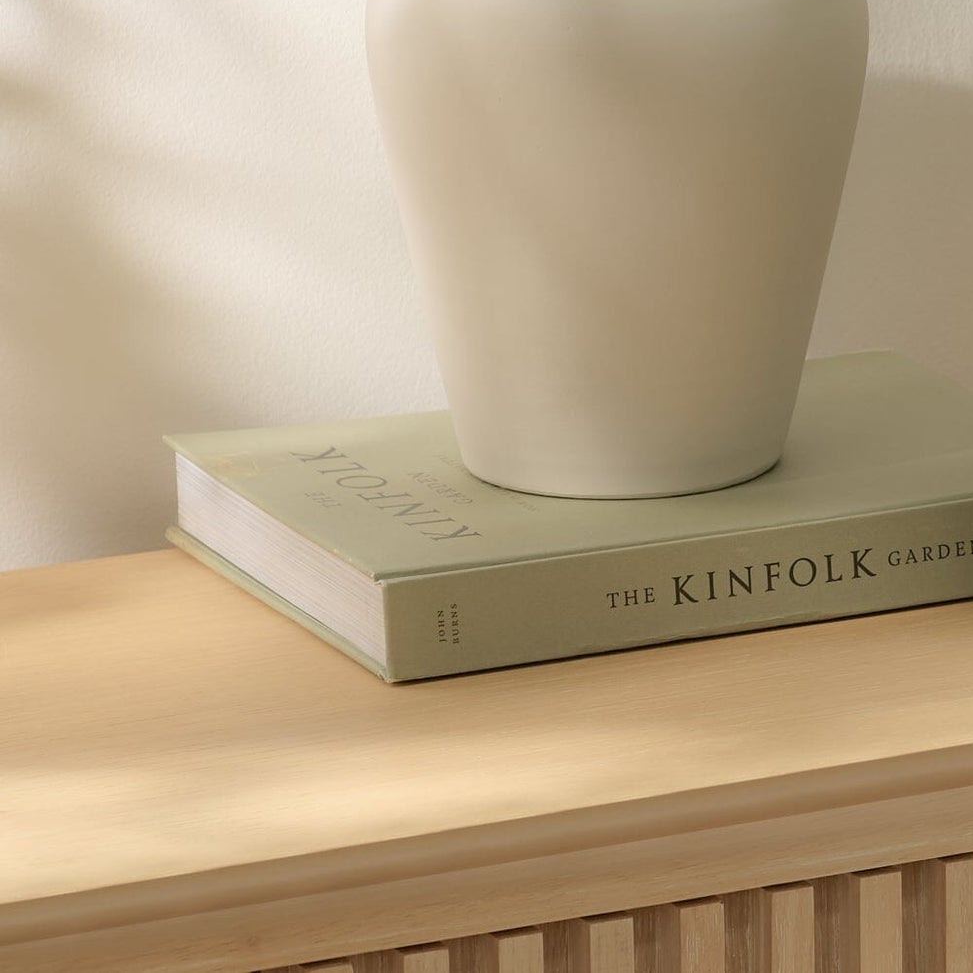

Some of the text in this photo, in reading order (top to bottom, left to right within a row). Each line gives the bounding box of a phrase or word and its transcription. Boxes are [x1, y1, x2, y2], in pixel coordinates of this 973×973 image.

[289, 446, 483, 541] KINFOLK
[606, 587, 656, 609] THE
[671, 548, 877, 606] KINFOLK
[437, 610, 448, 643] JOHN
[450, 603, 460, 644] BURNS
